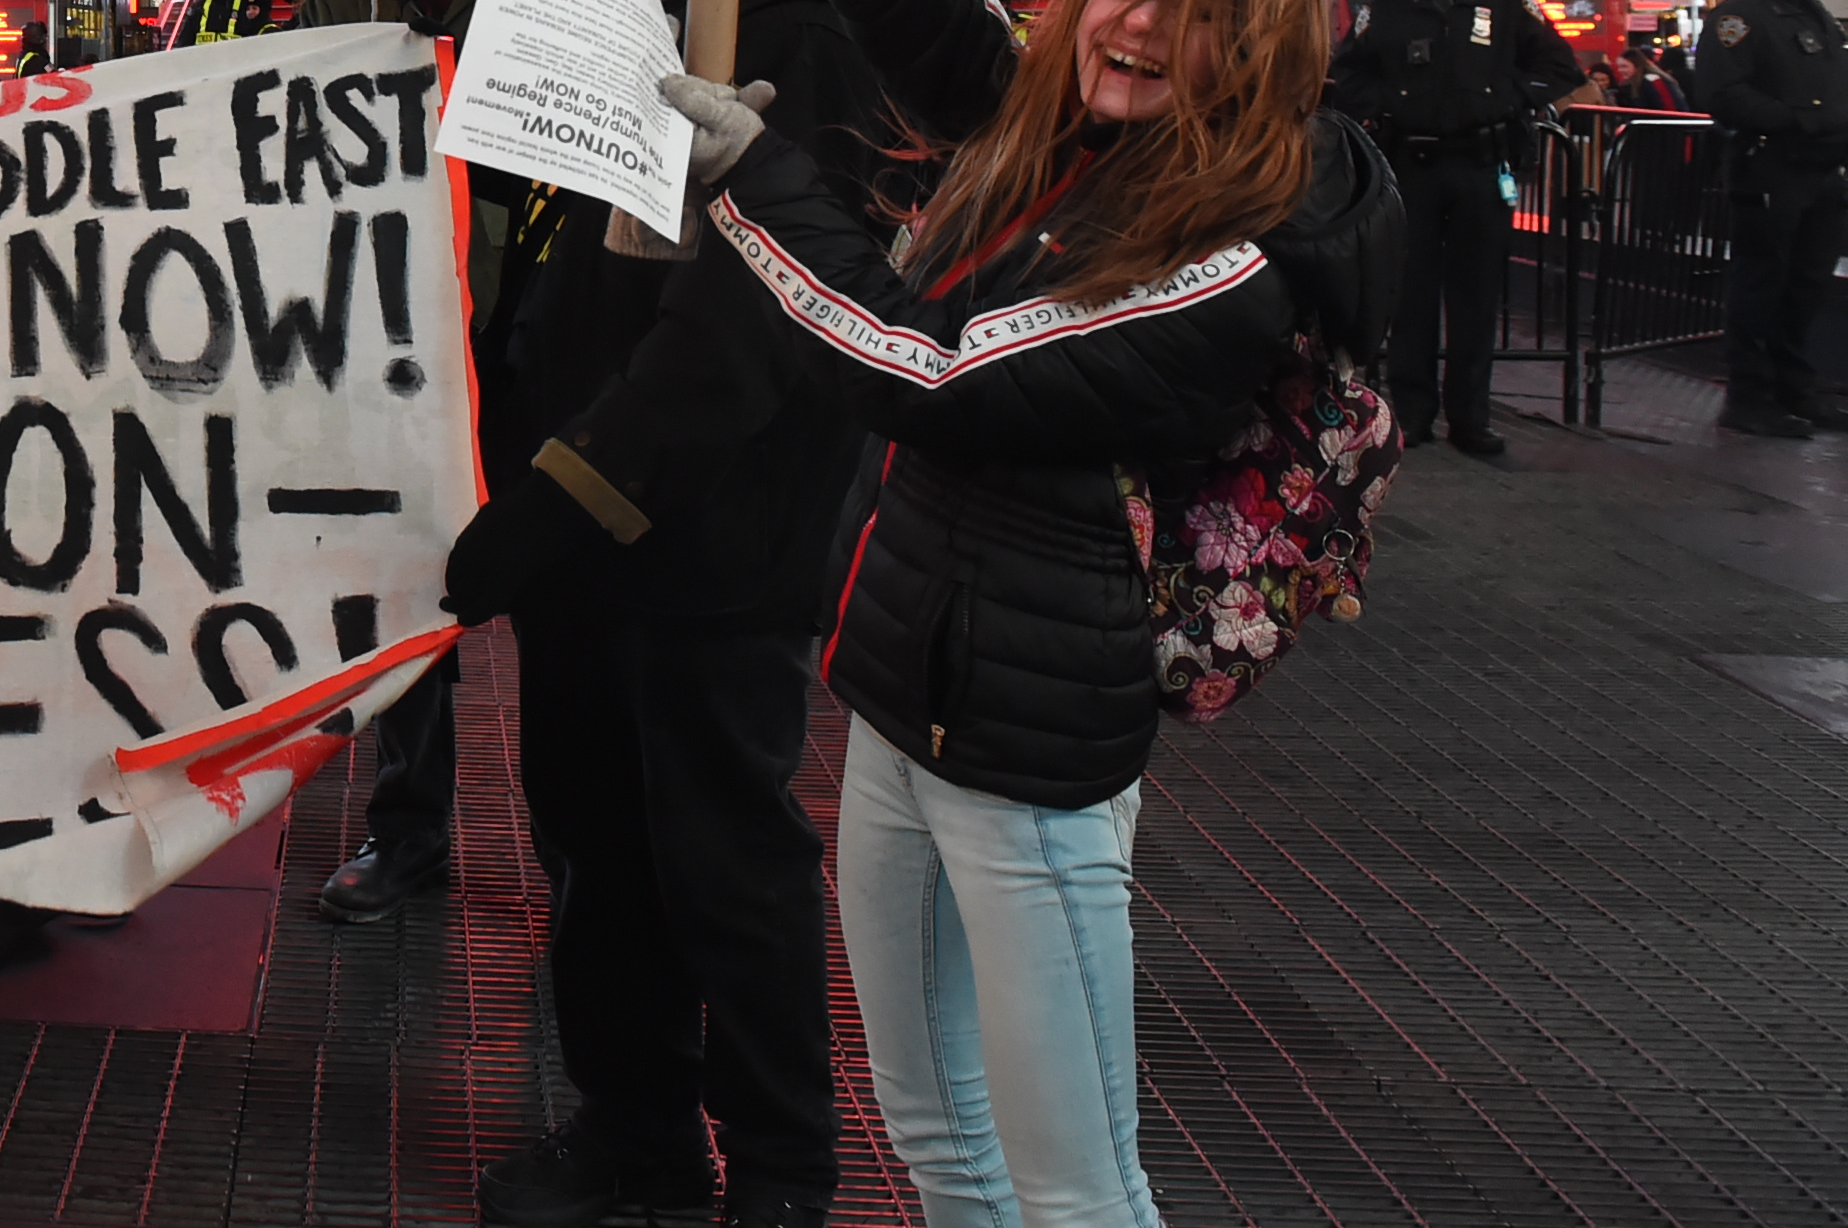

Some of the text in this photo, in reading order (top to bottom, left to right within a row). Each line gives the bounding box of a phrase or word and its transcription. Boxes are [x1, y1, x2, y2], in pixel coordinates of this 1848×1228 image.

[485, 78, 548, 108] Regime
[535, 75, 643, 130] Must Go NOW!
[553, 98, 648, 153] Trump/Pence
[231, 65, 437, 206] EAST
[466, 95, 649, 177] #OUTNOW! Movement
[712, 199, 772, 275] TOMMY
[5, 209, 427, 399] NOW!
[790, 285, 884, 353] HILFIGER
